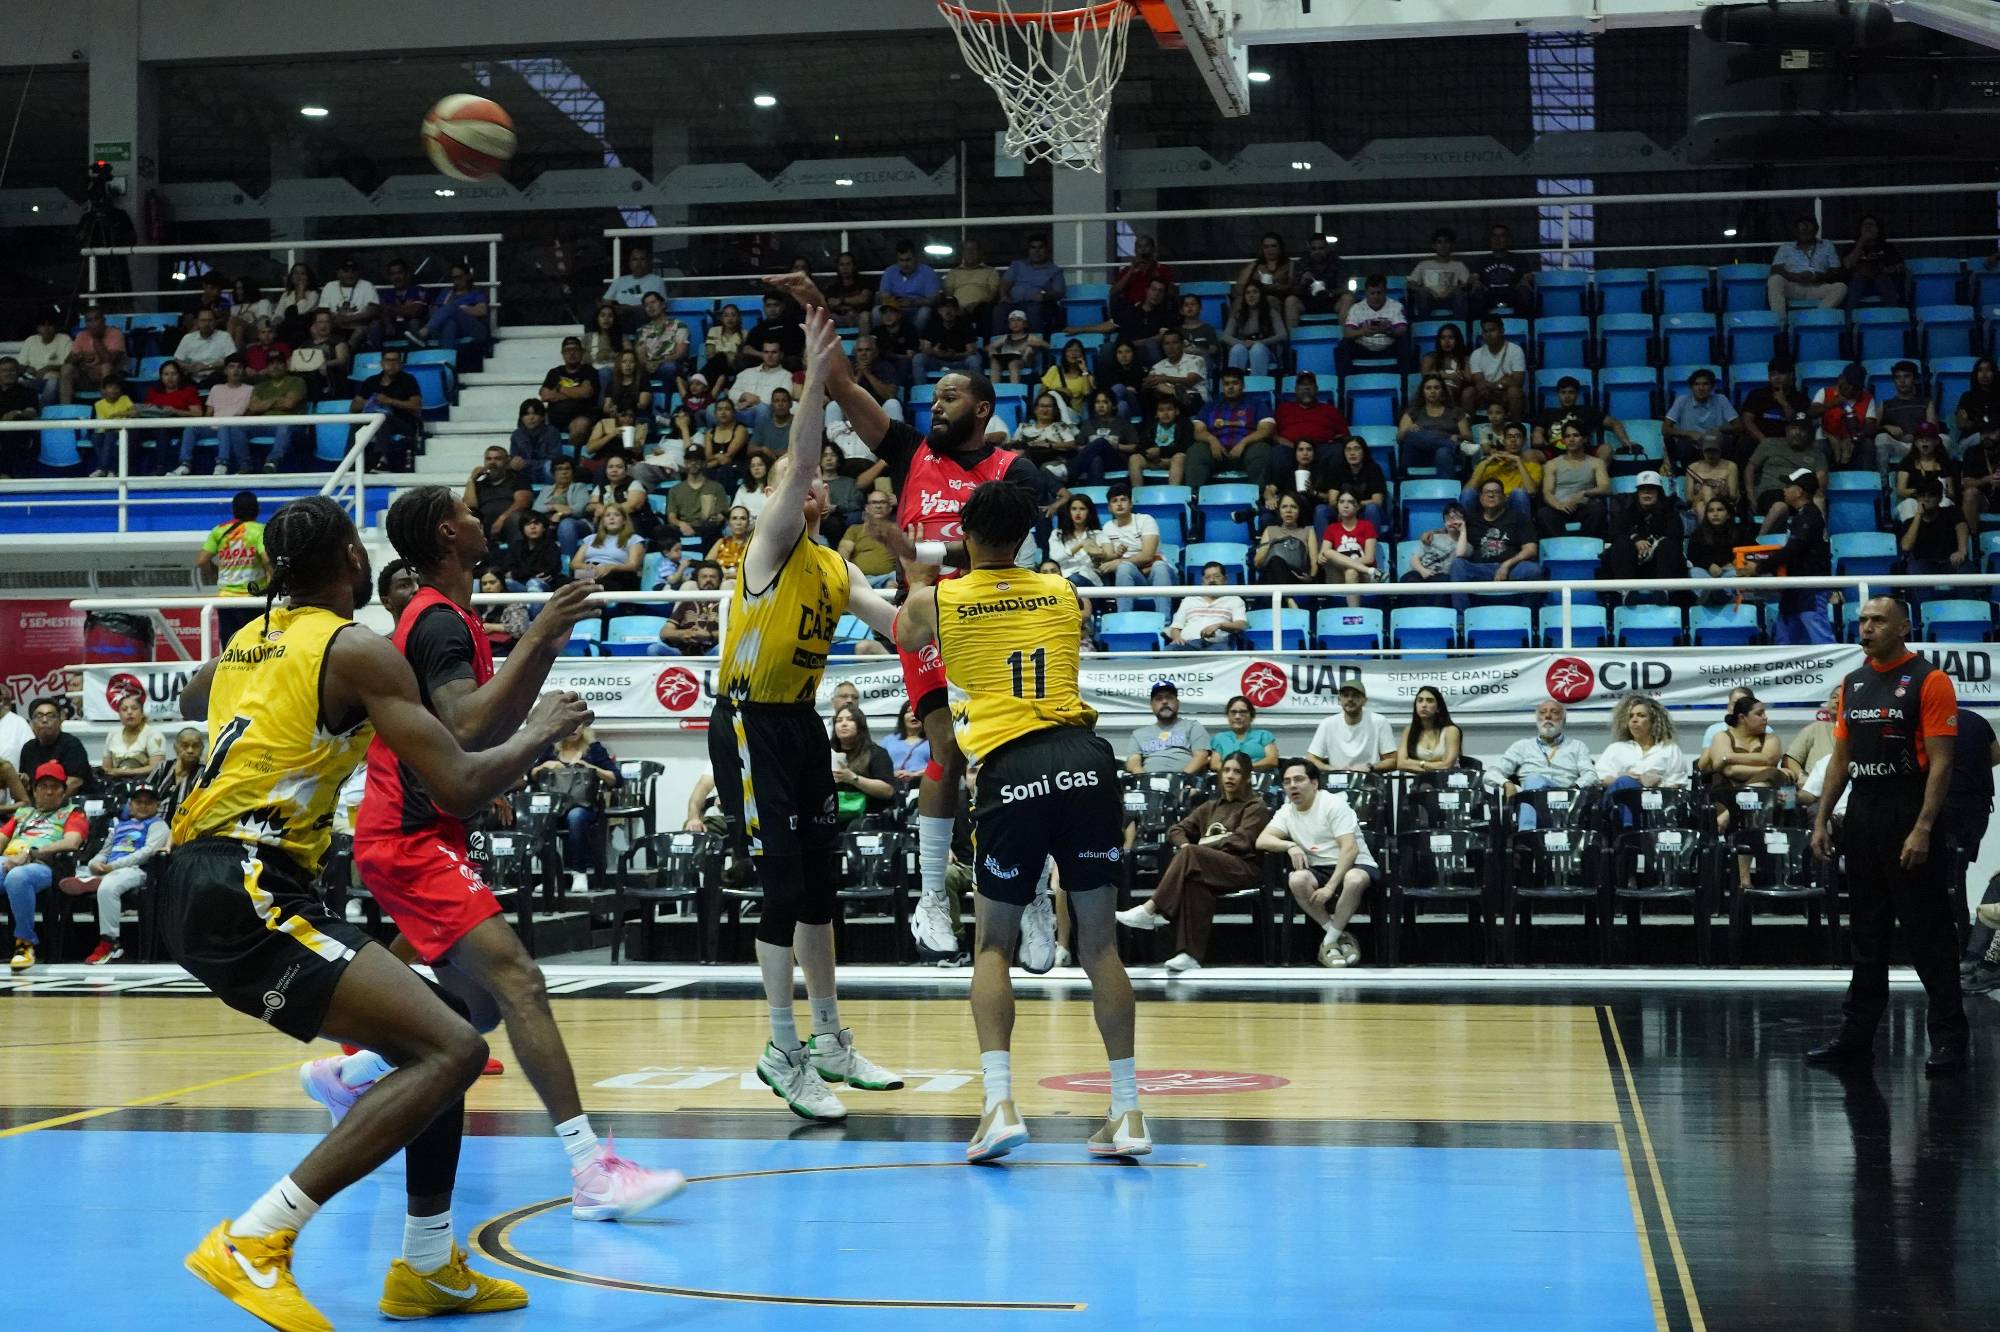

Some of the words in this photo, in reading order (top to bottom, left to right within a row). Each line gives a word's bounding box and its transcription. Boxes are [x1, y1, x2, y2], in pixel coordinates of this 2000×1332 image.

[957, 595, 1057, 619] SaludDigna
[1006, 647, 1046, 699] 11
[1699, 664, 1761, 675] SIEMPRE
[1765, 659, 1834, 671] GRANDES
[570, 677, 632, 686] GRANDES
[1086, 673, 1144, 682] SIEMPRE
[1148, 672, 1214, 682] GRANDES
[1388, 672, 1447, 682] SIEMPRE
[1452, 669, 1520, 680] GRANDES
[1599, 661, 1672, 691] CID
[1709, 676, 1771, 688] SIEMPRE
[1775, 674, 1824, 685] LOBOS
[578, 691, 623, 701] LOBOS
[1462, 685, 1509, 695] LOBOS
[1000, 774, 1050, 804] Soni
[1055, 770, 1099, 791] Gas
[1078, 849, 1108, 860] adsum
